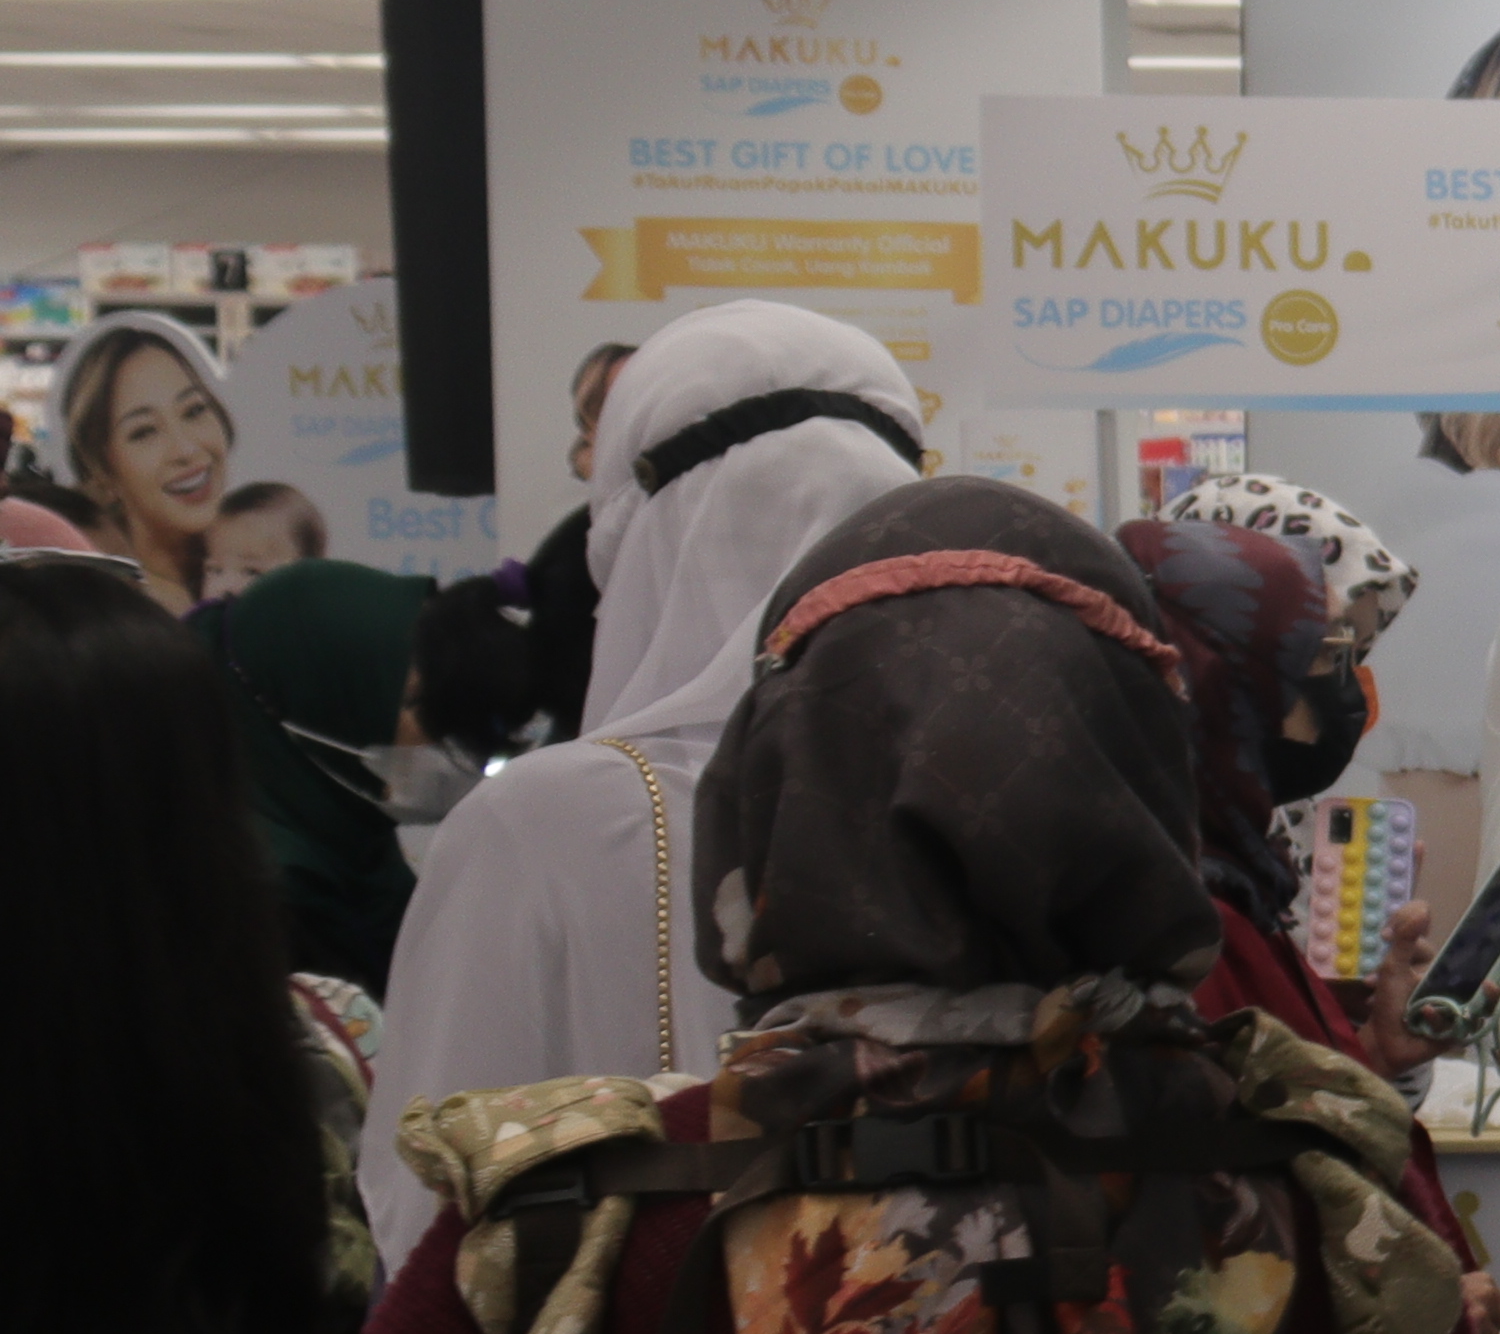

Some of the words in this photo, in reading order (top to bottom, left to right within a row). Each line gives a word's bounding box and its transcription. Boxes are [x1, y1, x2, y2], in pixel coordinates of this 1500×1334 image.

[629, 138, 718, 168] BEST
[731, 140, 810, 170] GIFT
[823, 142, 873, 171] OF
[886, 144, 977, 174] LOVE
[1013, 297, 1089, 329] SAP
[1100, 299, 1247, 330] DIAPERS
[367, 498, 463, 540] Best
